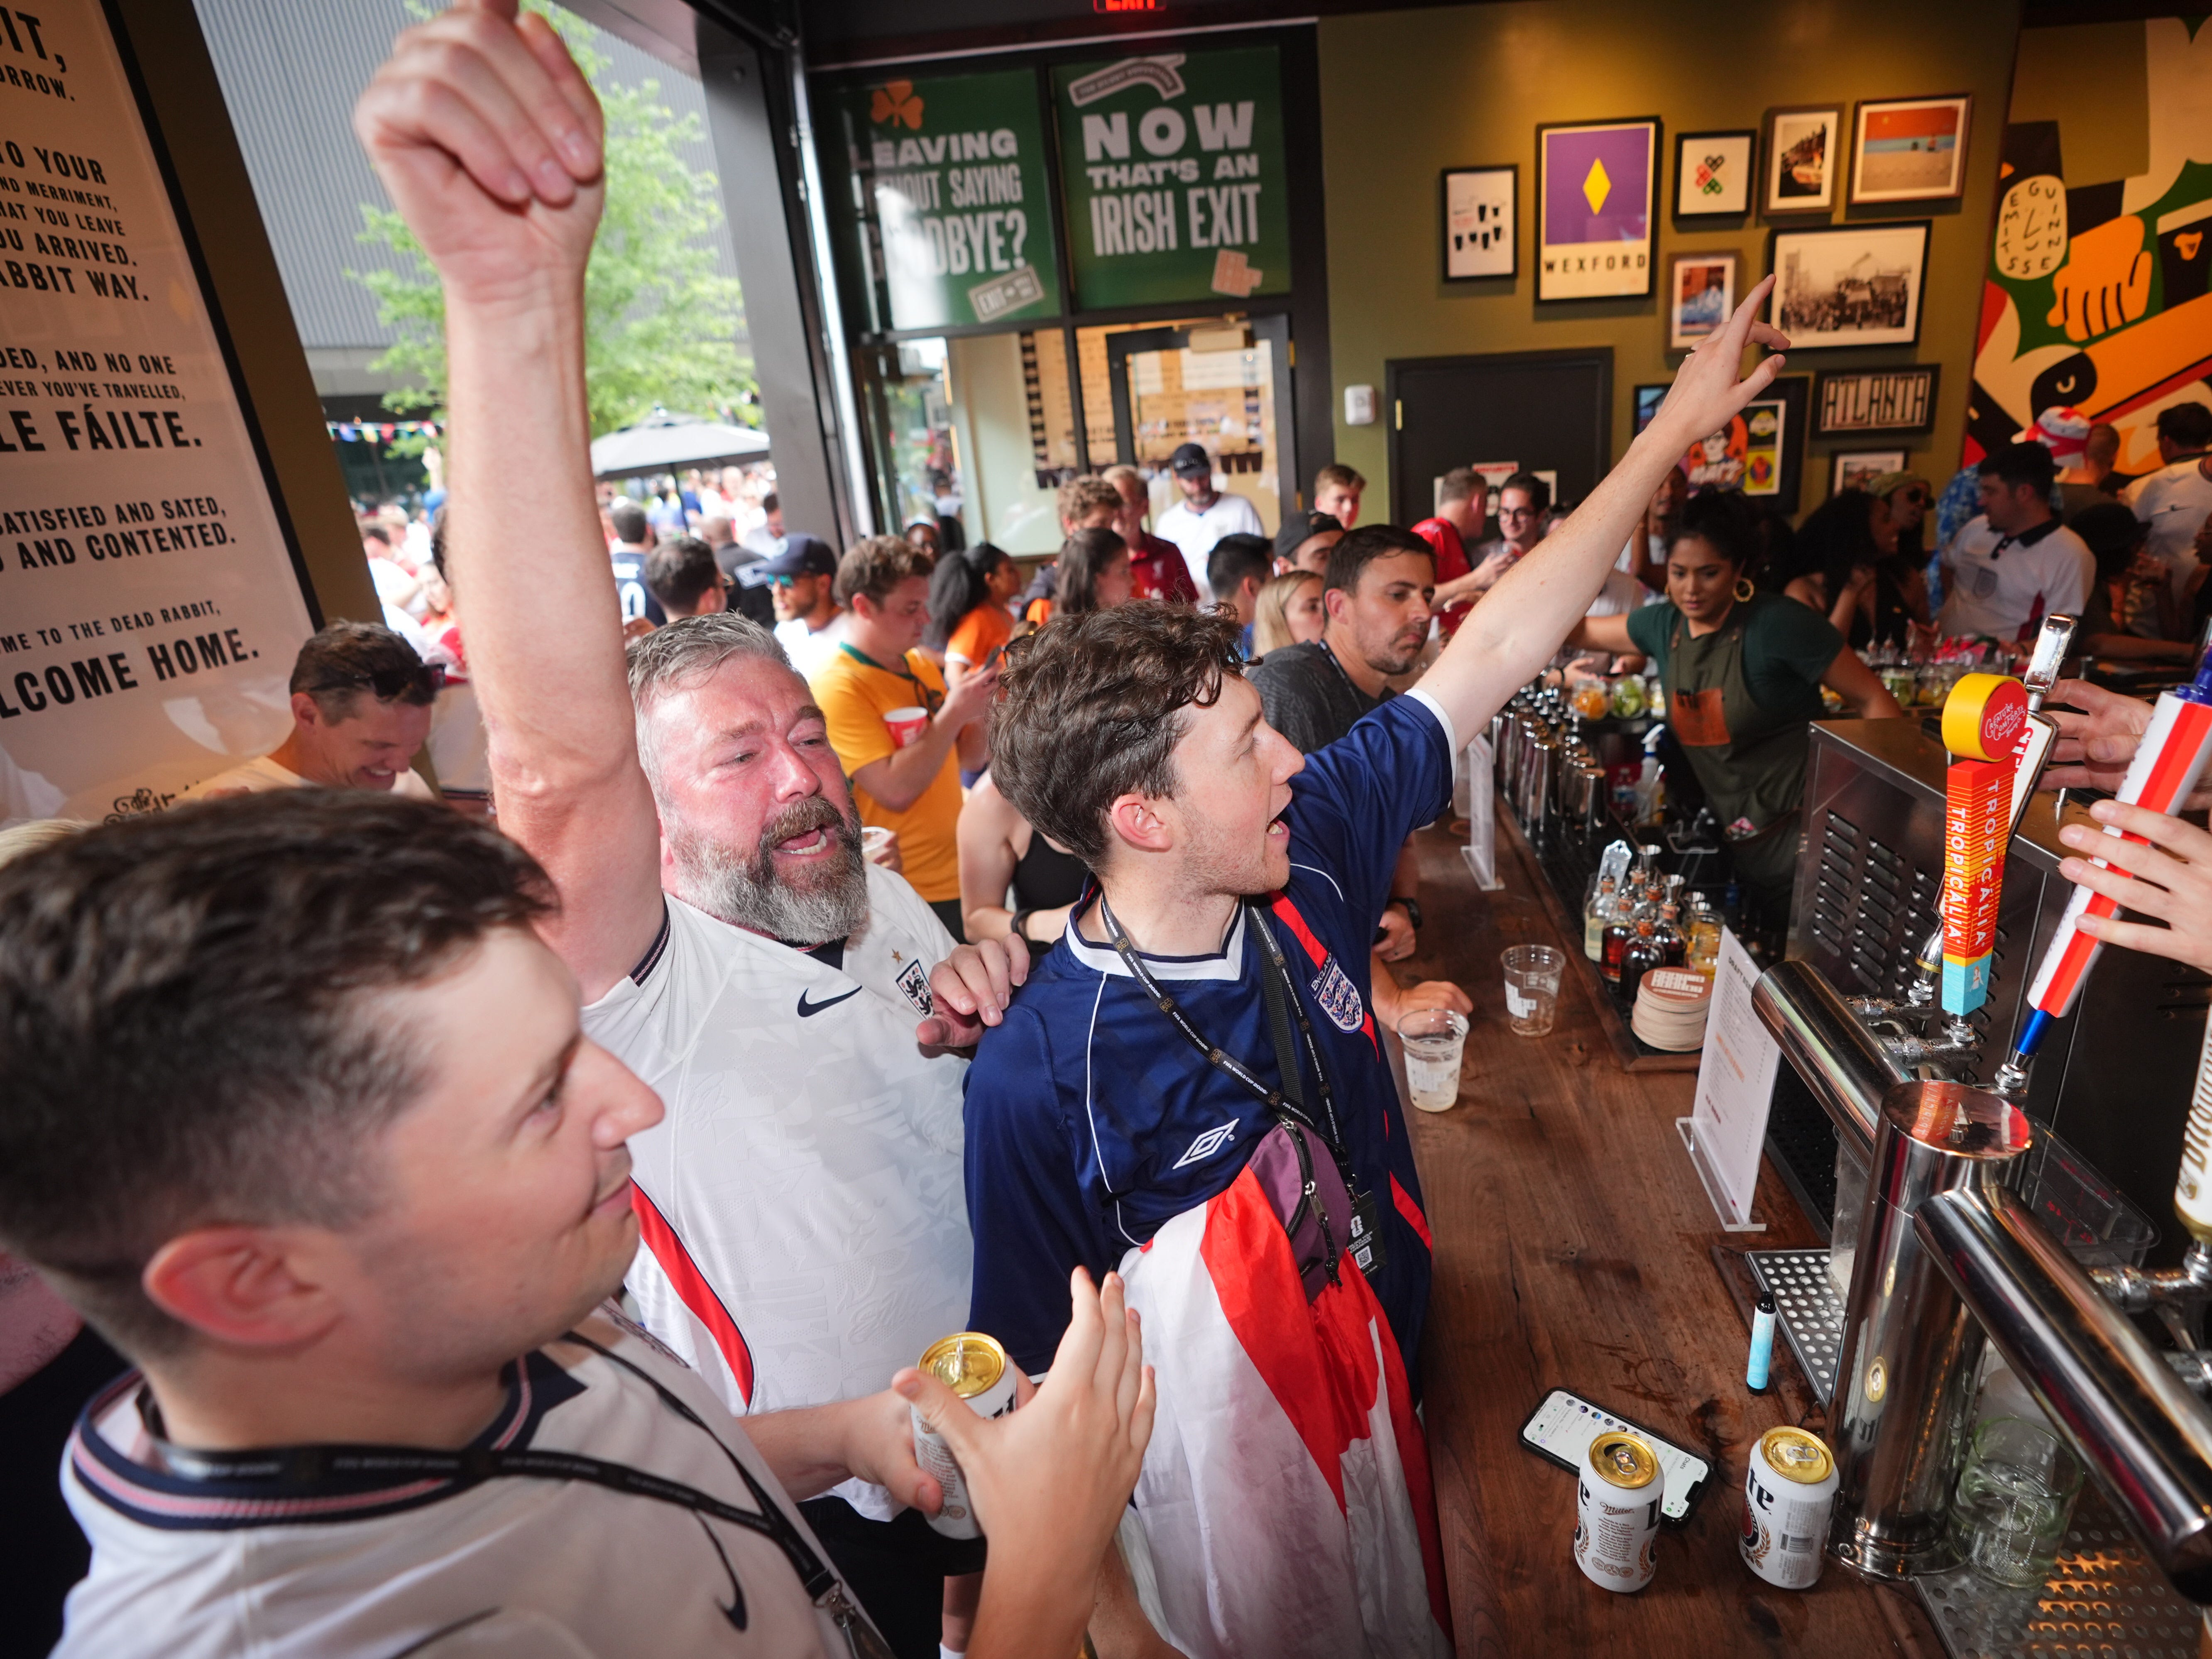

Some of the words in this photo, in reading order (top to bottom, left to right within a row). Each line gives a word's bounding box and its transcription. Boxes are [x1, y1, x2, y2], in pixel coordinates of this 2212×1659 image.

[1082, 101, 1255, 161] NOW
[33, 146, 107, 185] YOUR
[1086, 157, 1200, 190] THAT'S
[1214, 154, 1259, 180] AN
[25, 180, 117, 213] MERRIMENT,
[948, 164, 1023, 208] SAYING
[33, 206, 70, 227] YOU
[75, 213, 126, 237] LEAVE
[1089, 189, 1178, 257] IRISH
[1187, 184, 1262, 248] EXIT
[34, 232, 137, 267] ARRIVED.
[1544, 253, 1647, 275] WEXFORD
[86, 270, 149, 301] WAY.
[54, 350, 97, 372] AND
[103, 352, 132, 373] NO
[138, 355, 176, 374] ONE
[42, 381, 100, 398] YOU'VE
[103, 383, 186, 401] TRAVELLED,
[1824, 373, 1928, 430] ATLANTA
[55, 403, 202, 450] FÁILTE.
[115, 502, 155, 525] AND
[161, 496, 227, 520] SATED,
[17, 538, 76, 569] AND
[86, 522, 236, 561] CONTENTED.
[37, 628, 62, 646] TO
[68, 620, 105, 641] THE
[110, 612, 154, 633] DEAD
[160, 600, 221, 623] RABBIT,
[147, 628, 260, 681] HOME.
[1948, 807, 1967, 938] TROPICÁLIA
[1975, 779, 1999, 946] TROPICÁLIA
[1132, 962, 1144, 977] WORLD
[1142, 975, 1150, 985] CUP
[1311, 952, 1332, 991] ENGLAND
[1179, 1019, 1192, 1033] WORLD
[1223, 1060, 1232, 1069] FIFA
[1232, 1066, 1246, 1079] WORLD
[1290, 1106, 1303, 1116] WORLD
[1680, 1457, 1691, 1470] Chats
[1600, 1501, 1635, 1515] Miller
